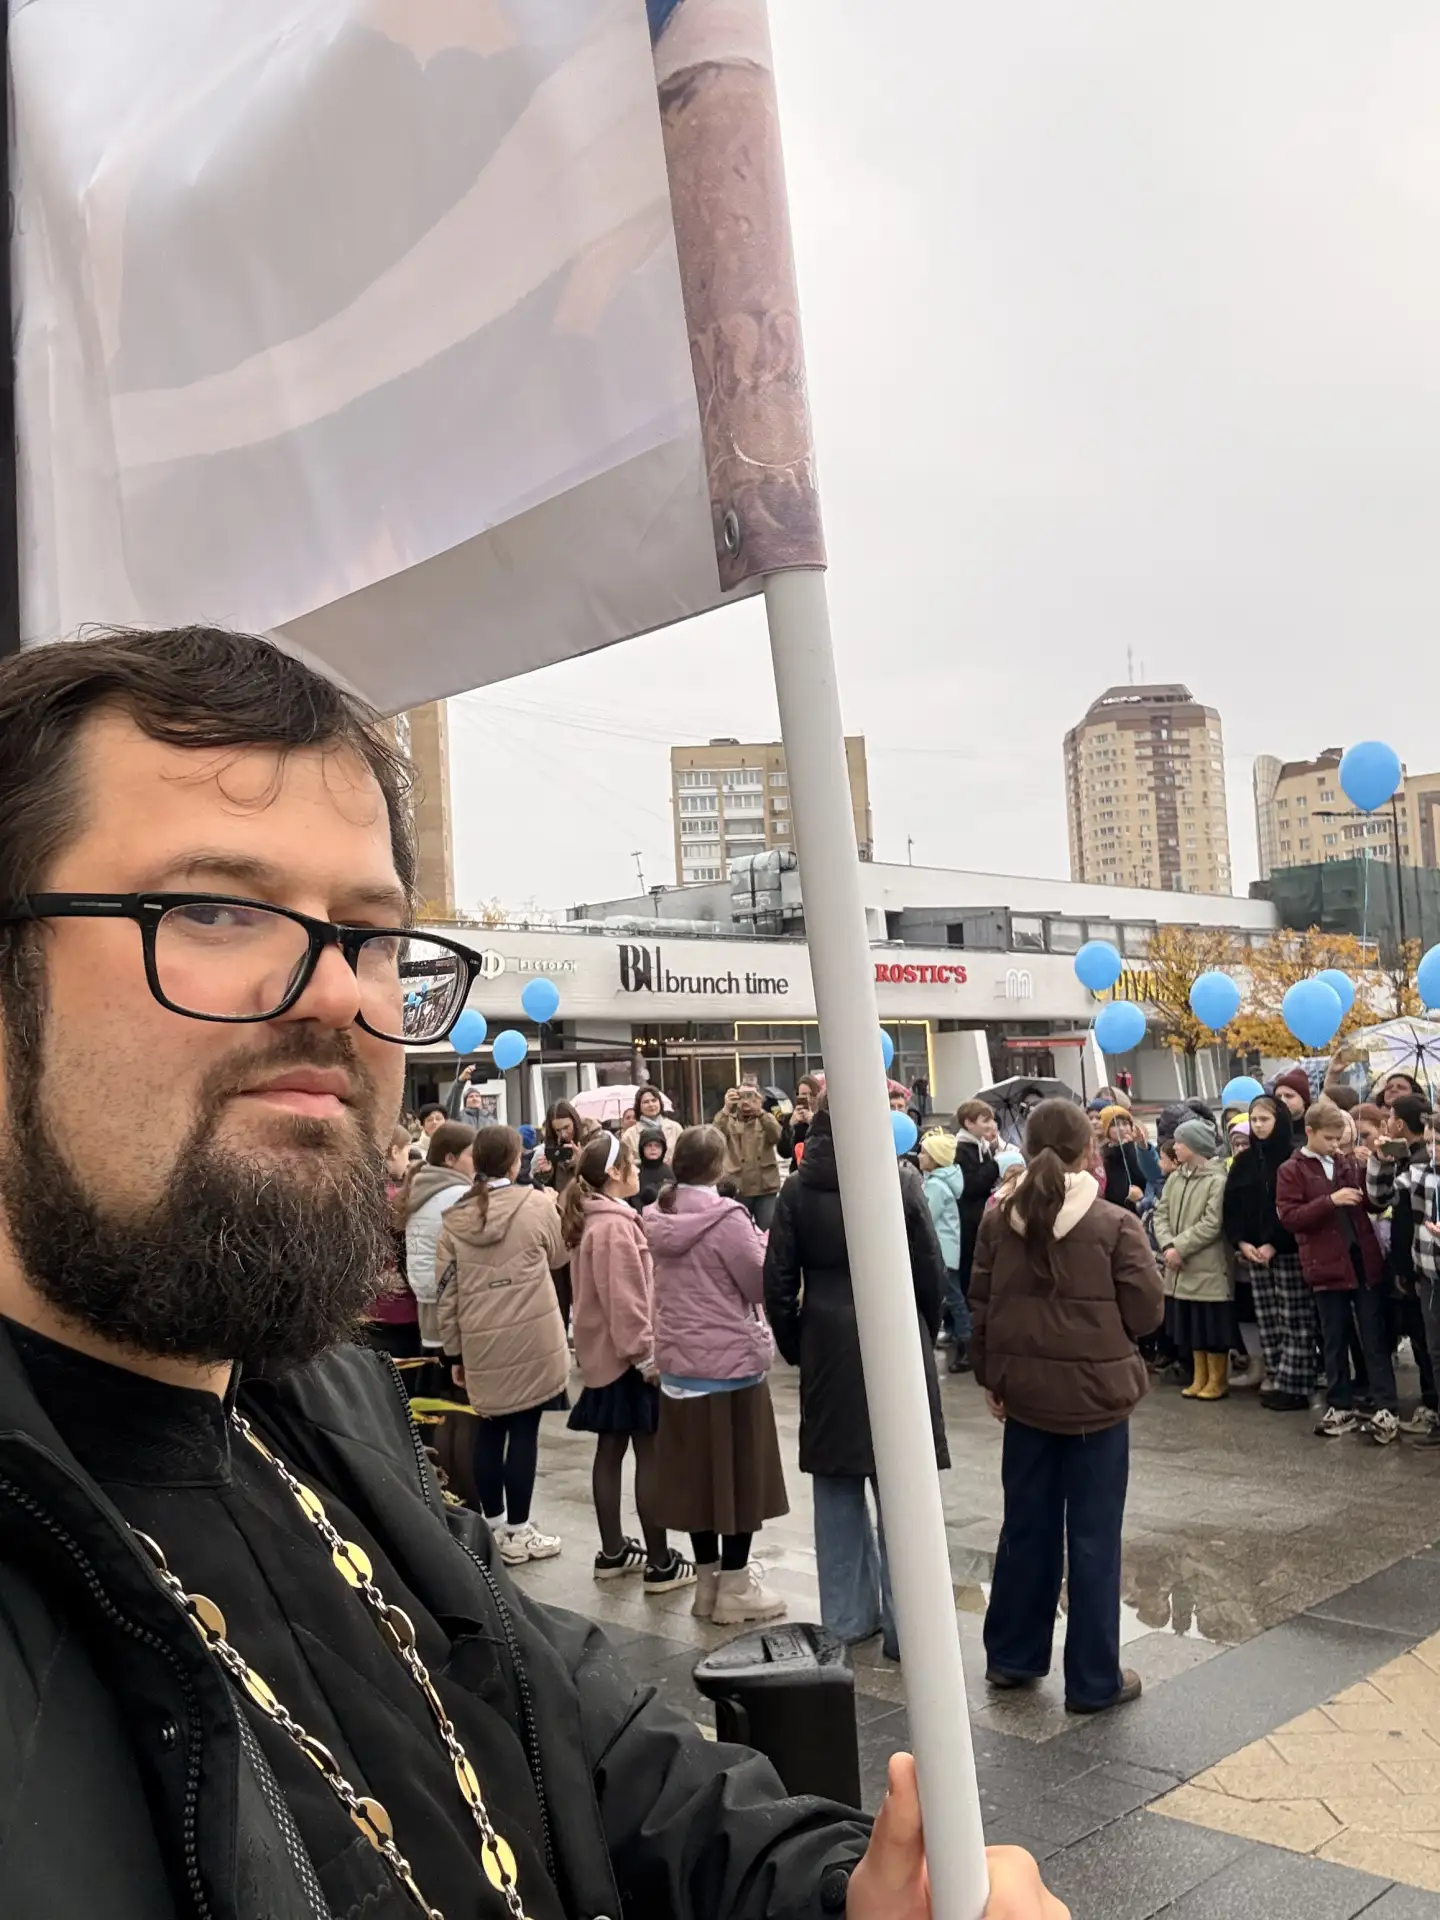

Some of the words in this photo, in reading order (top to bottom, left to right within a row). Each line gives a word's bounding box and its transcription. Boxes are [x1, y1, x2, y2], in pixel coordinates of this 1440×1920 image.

[665, 969, 740, 994] brunch
[745, 972, 789, 994] time
[875, 964, 967, 984] ROSTIC'S
